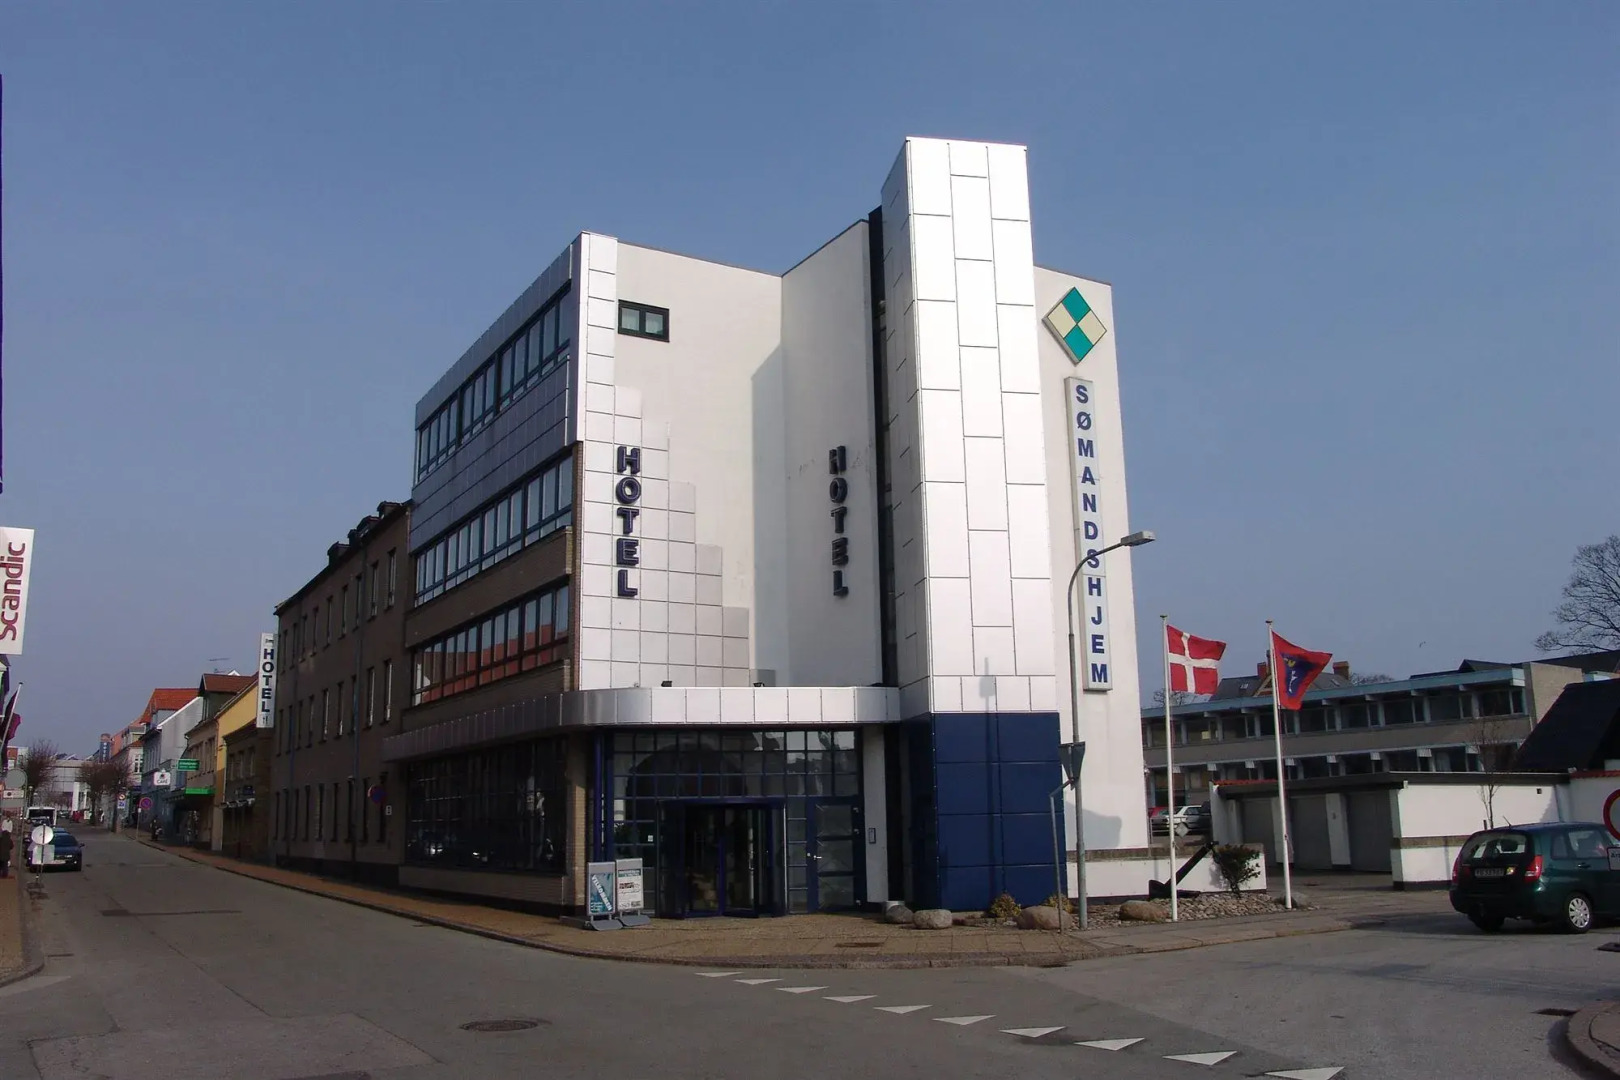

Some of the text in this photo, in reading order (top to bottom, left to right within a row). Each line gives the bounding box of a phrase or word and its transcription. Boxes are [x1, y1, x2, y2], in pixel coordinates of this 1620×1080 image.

[0, 541, 26, 641] Scandic
[615, 445, 642, 598] HOTEL
[828, 445, 849, 597] HOTEL
[1075, 384, 1109, 684] SØMANDSHJEM
[261, 648, 275, 713] HOTEL
